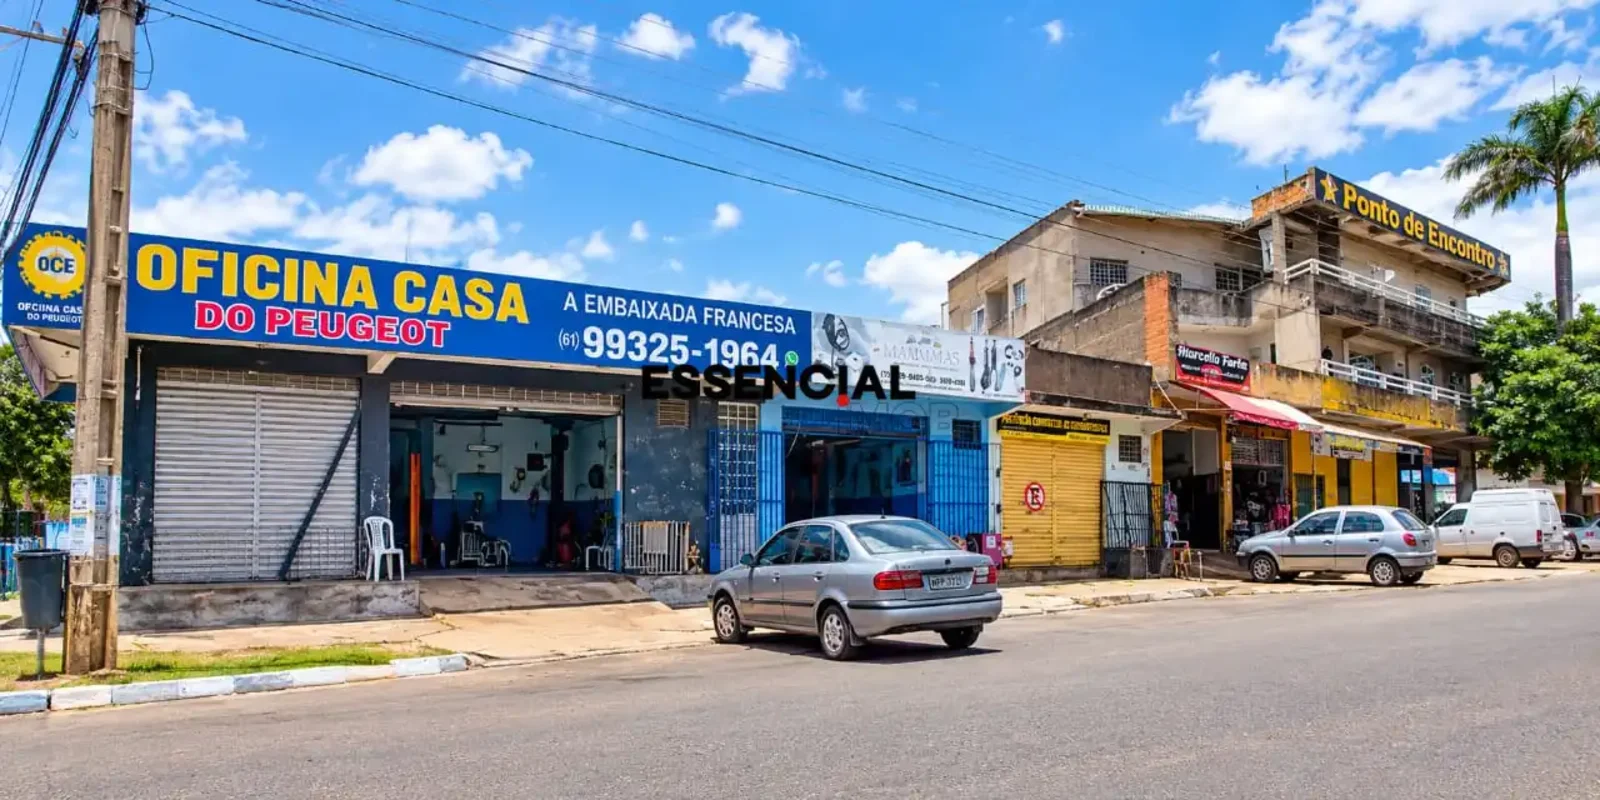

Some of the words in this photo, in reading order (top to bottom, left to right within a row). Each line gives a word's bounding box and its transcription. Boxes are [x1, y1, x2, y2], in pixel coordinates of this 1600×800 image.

[1343, 183, 1400, 229] Ponto
[1403, 210, 1425, 241] de
[1428, 220, 1496, 270] Encontro
[37, 255, 76, 274] OCE
[136, 244, 377, 309] OFICINA
[393, 270, 530, 324] CASA
[62, 304, 84, 316] CAS
[194, 299, 256, 334] DO
[265, 304, 452, 350] PEUGEOT
[563, 291, 579, 312] A
[584, 293, 698, 325] EMBAIXADA
[703, 306, 797, 335] FRANCESA
[558, 329, 580, 351] (61)
[583, 325, 780, 371] 99325-1964
